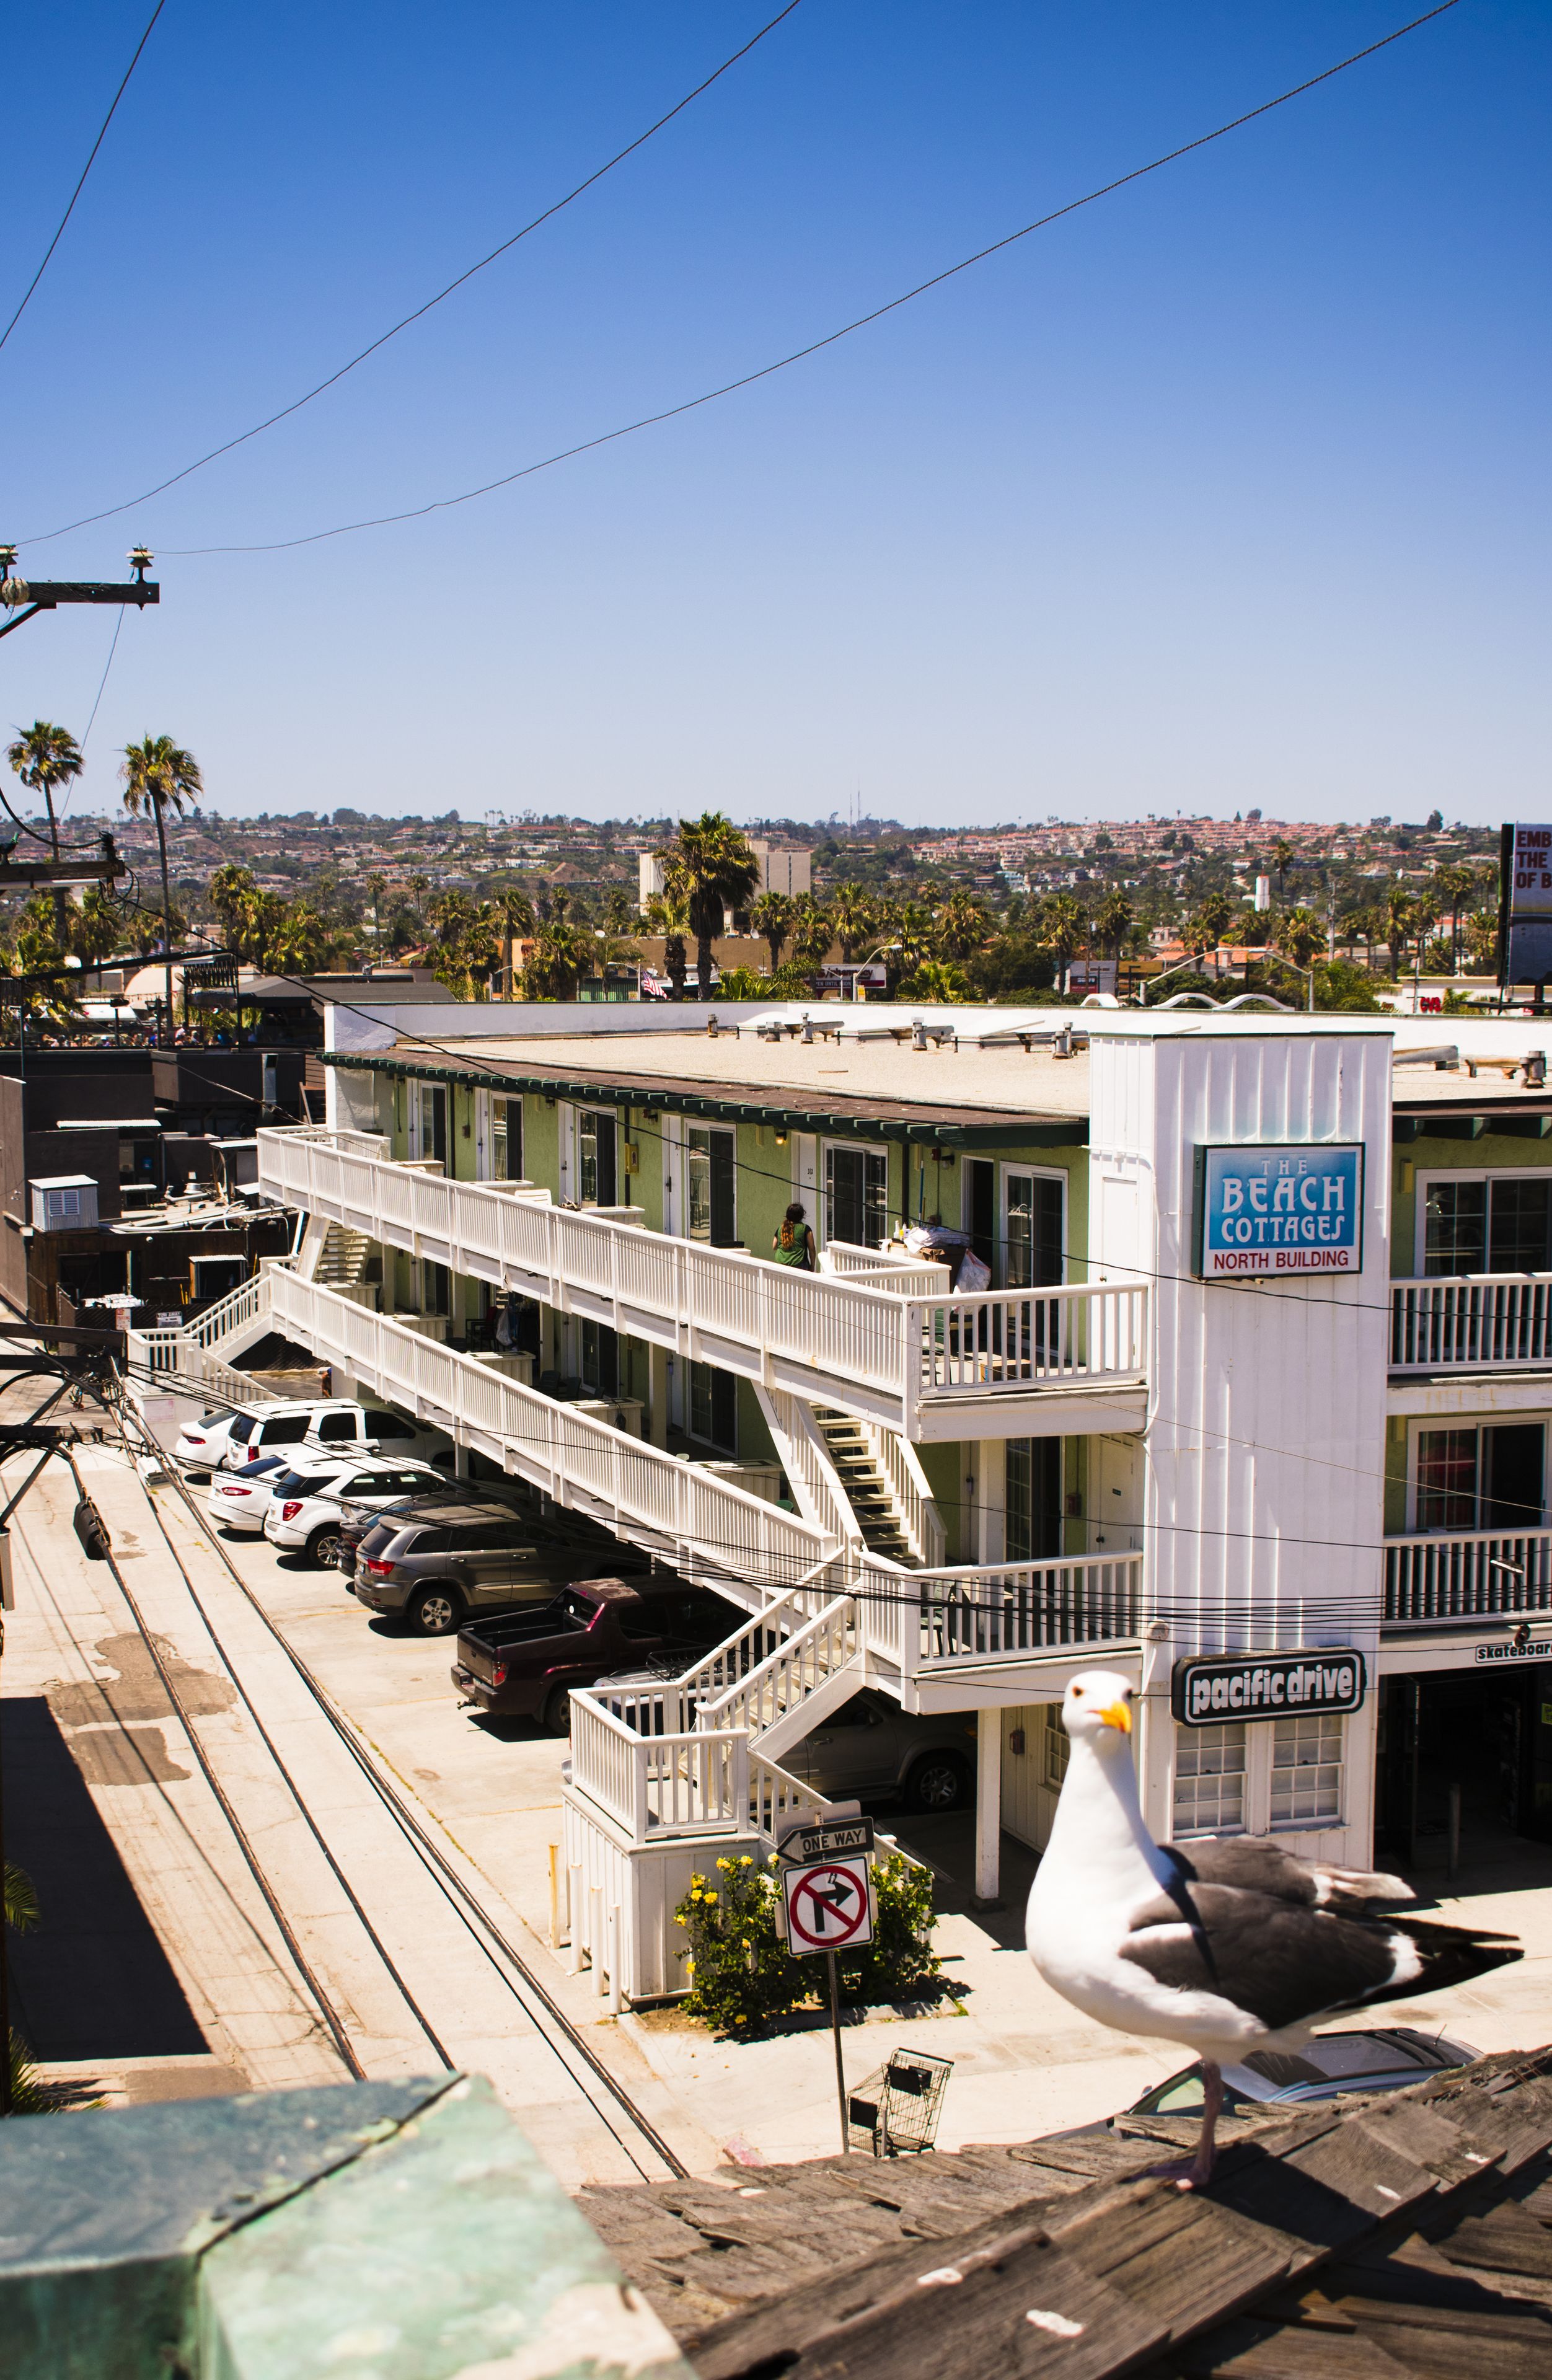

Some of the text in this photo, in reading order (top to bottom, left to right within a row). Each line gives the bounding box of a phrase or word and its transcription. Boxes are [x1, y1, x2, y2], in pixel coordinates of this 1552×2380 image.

[1517, 852, 1548, 868] THE
[1516, 872, 1537, 889] OF
[1421, 997, 1441, 1012] CVS
[1261, 1160, 1307, 1175] THE
[1222, 1176, 1346, 1214] BEACH
[1221, 1215, 1345, 1243] COTTAGES
[1214, 1250, 1349, 1269] NORTH BUILDING
[1478, 1643, 1552, 1659] skateboar
[1193, 1664, 1353, 1714] pacific drive
[803, 1829, 862, 1853] ONE WAY
